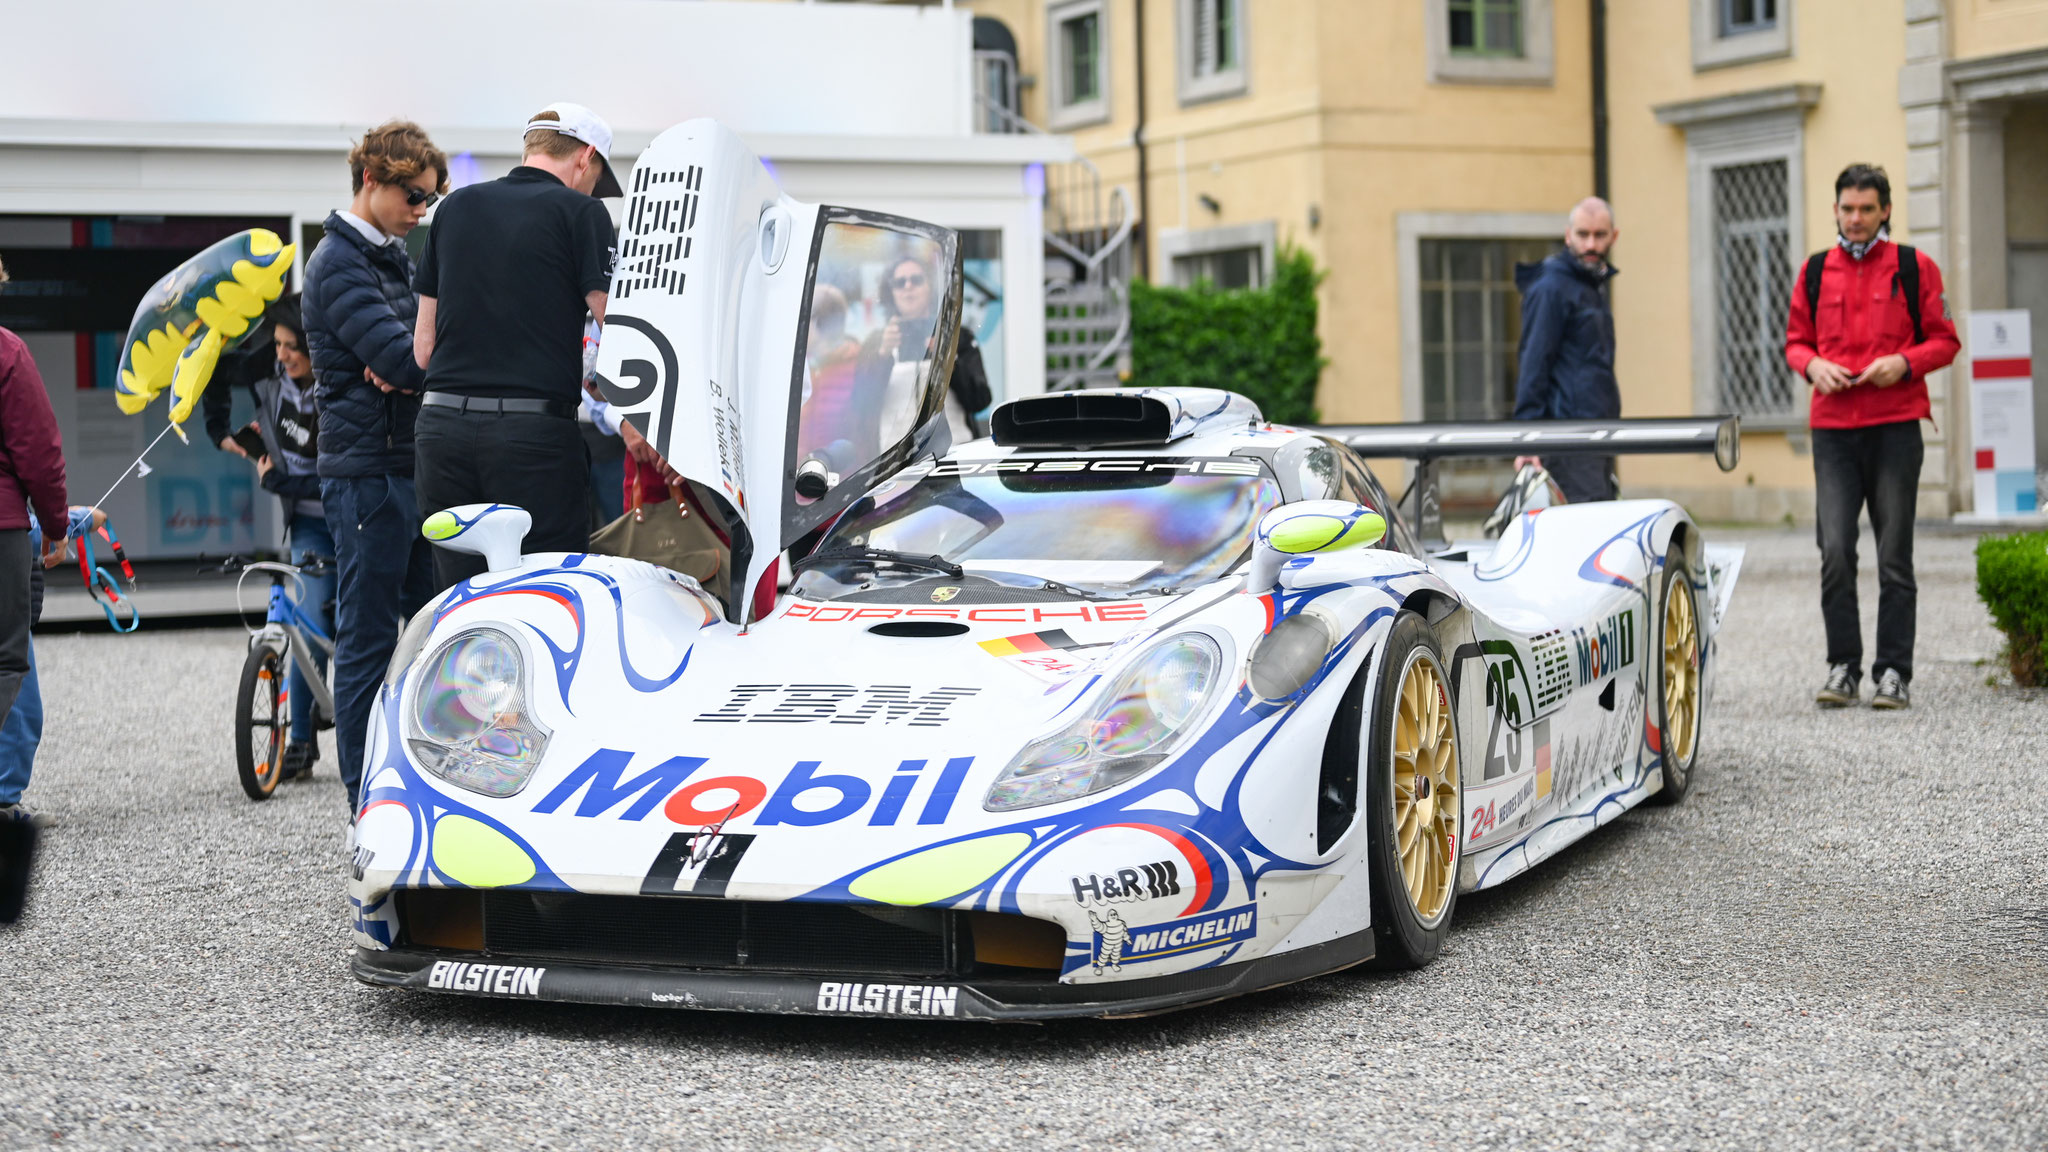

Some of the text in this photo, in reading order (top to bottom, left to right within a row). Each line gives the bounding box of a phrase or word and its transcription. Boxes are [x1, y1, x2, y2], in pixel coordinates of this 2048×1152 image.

[615, 165, 703, 299] IBM
[710, 379, 730, 469] B. Wollek
[893, 460, 1261, 478] PORSCHE
[778, 602, 1148, 622] PORSCHE
[1571, 610, 1634, 688] Mobil 1
[692, 684, 982, 727] IBM
[1484, 659, 1523, 782] 25
[530, 748, 976, 827] Mobil
[1468, 800, 1497, 844] 24
[1071, 868, 1143, 903] H&R
[1131, 910, 1254, 953] MICHELIN
[428, 960, 546, 995] BILSTEIN
[817, 982, 959, 1016] BILSTEIN
